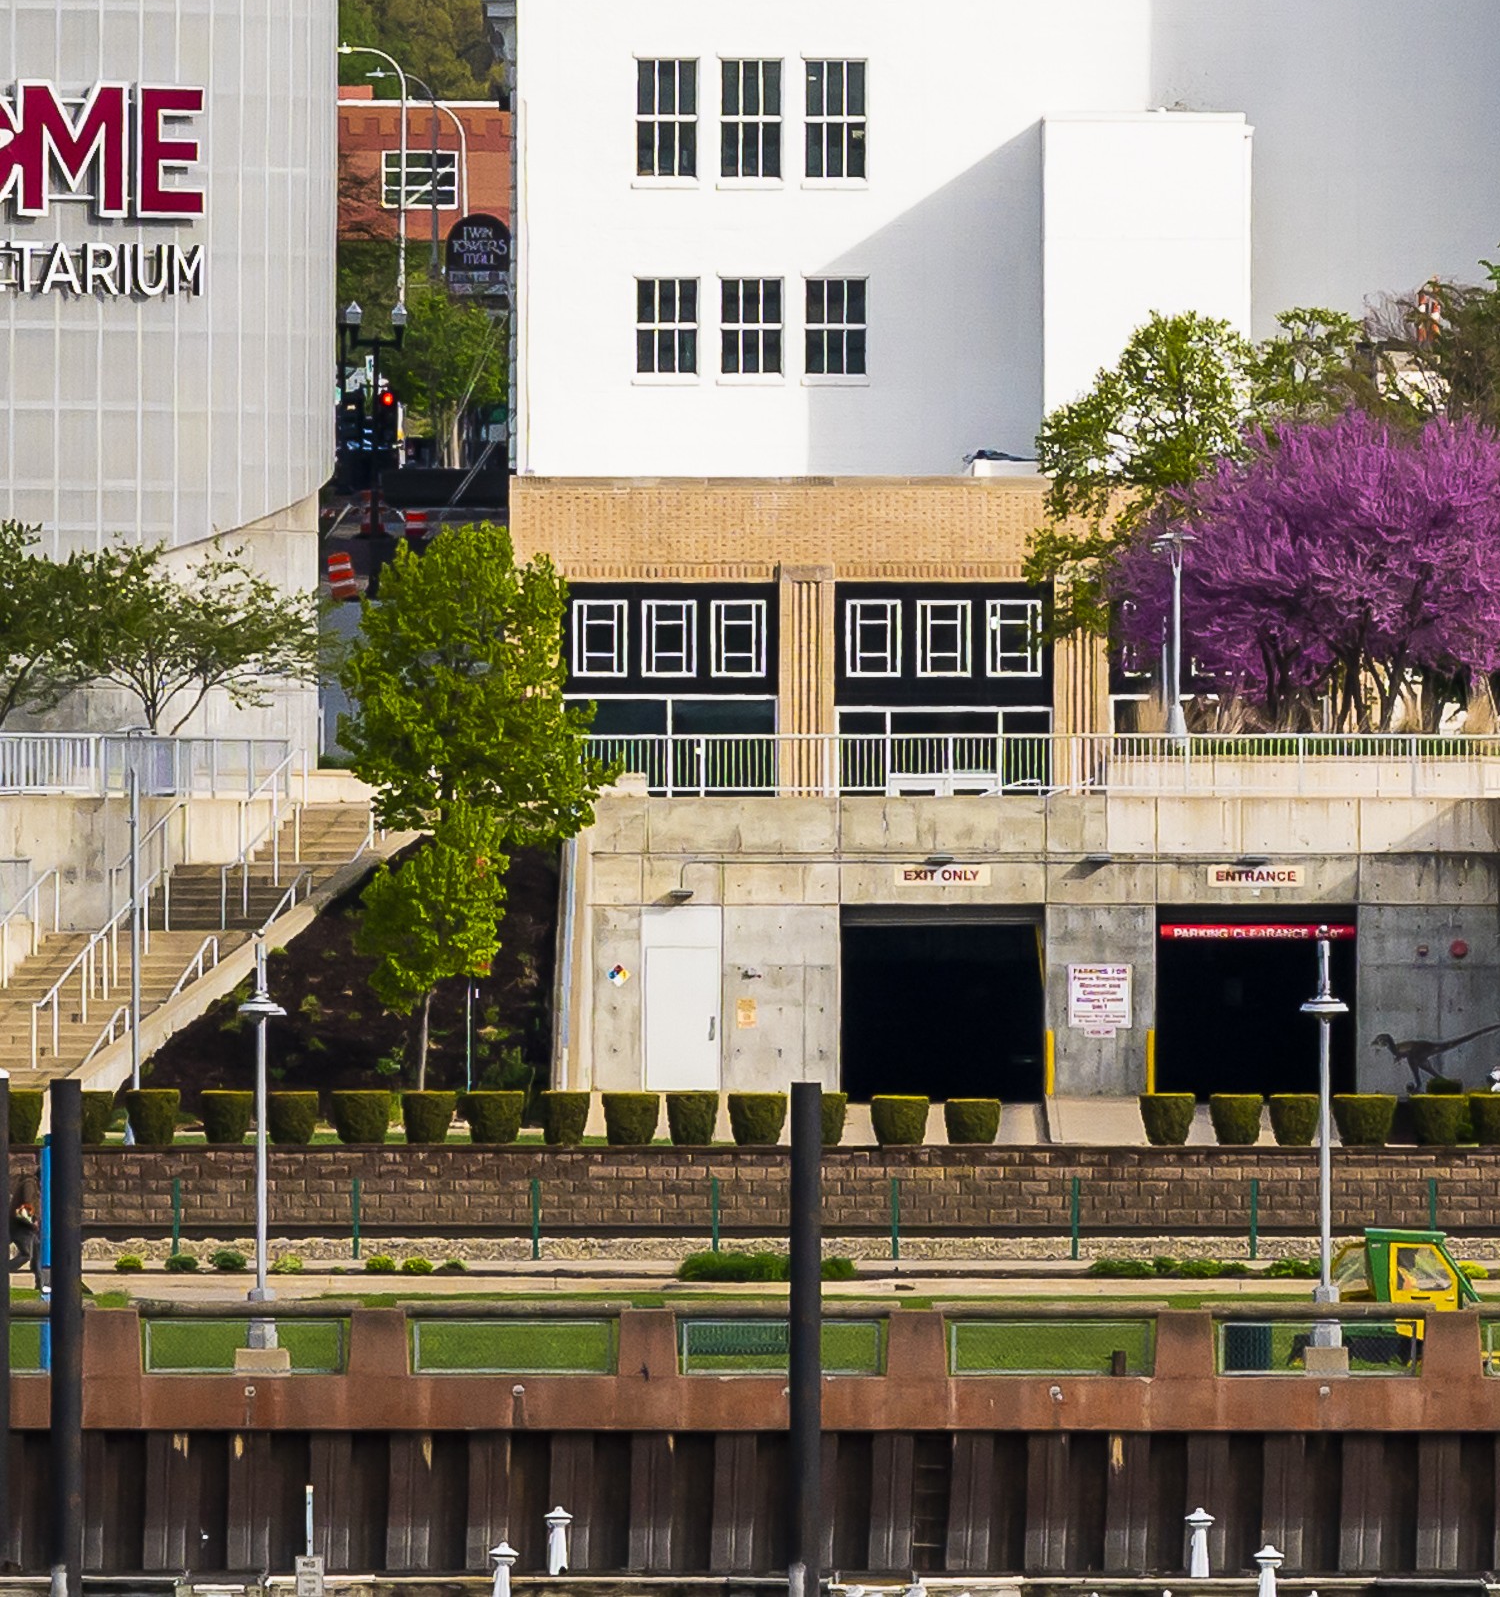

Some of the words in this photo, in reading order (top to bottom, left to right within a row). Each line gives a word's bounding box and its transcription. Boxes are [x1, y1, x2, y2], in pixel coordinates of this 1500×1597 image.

[0, 79, 205, 218] ME
[0, 240, 205, 296] TARIUM
[903, 870, 937, 881] EXIT
[941, 870, 979, 881] ONLY
[1215, 870, 1297, 882] ENTRANCE
[1174, 928, 1228, 938] PARKING
[1233, 928, 1308, 938] CLEARANCE
